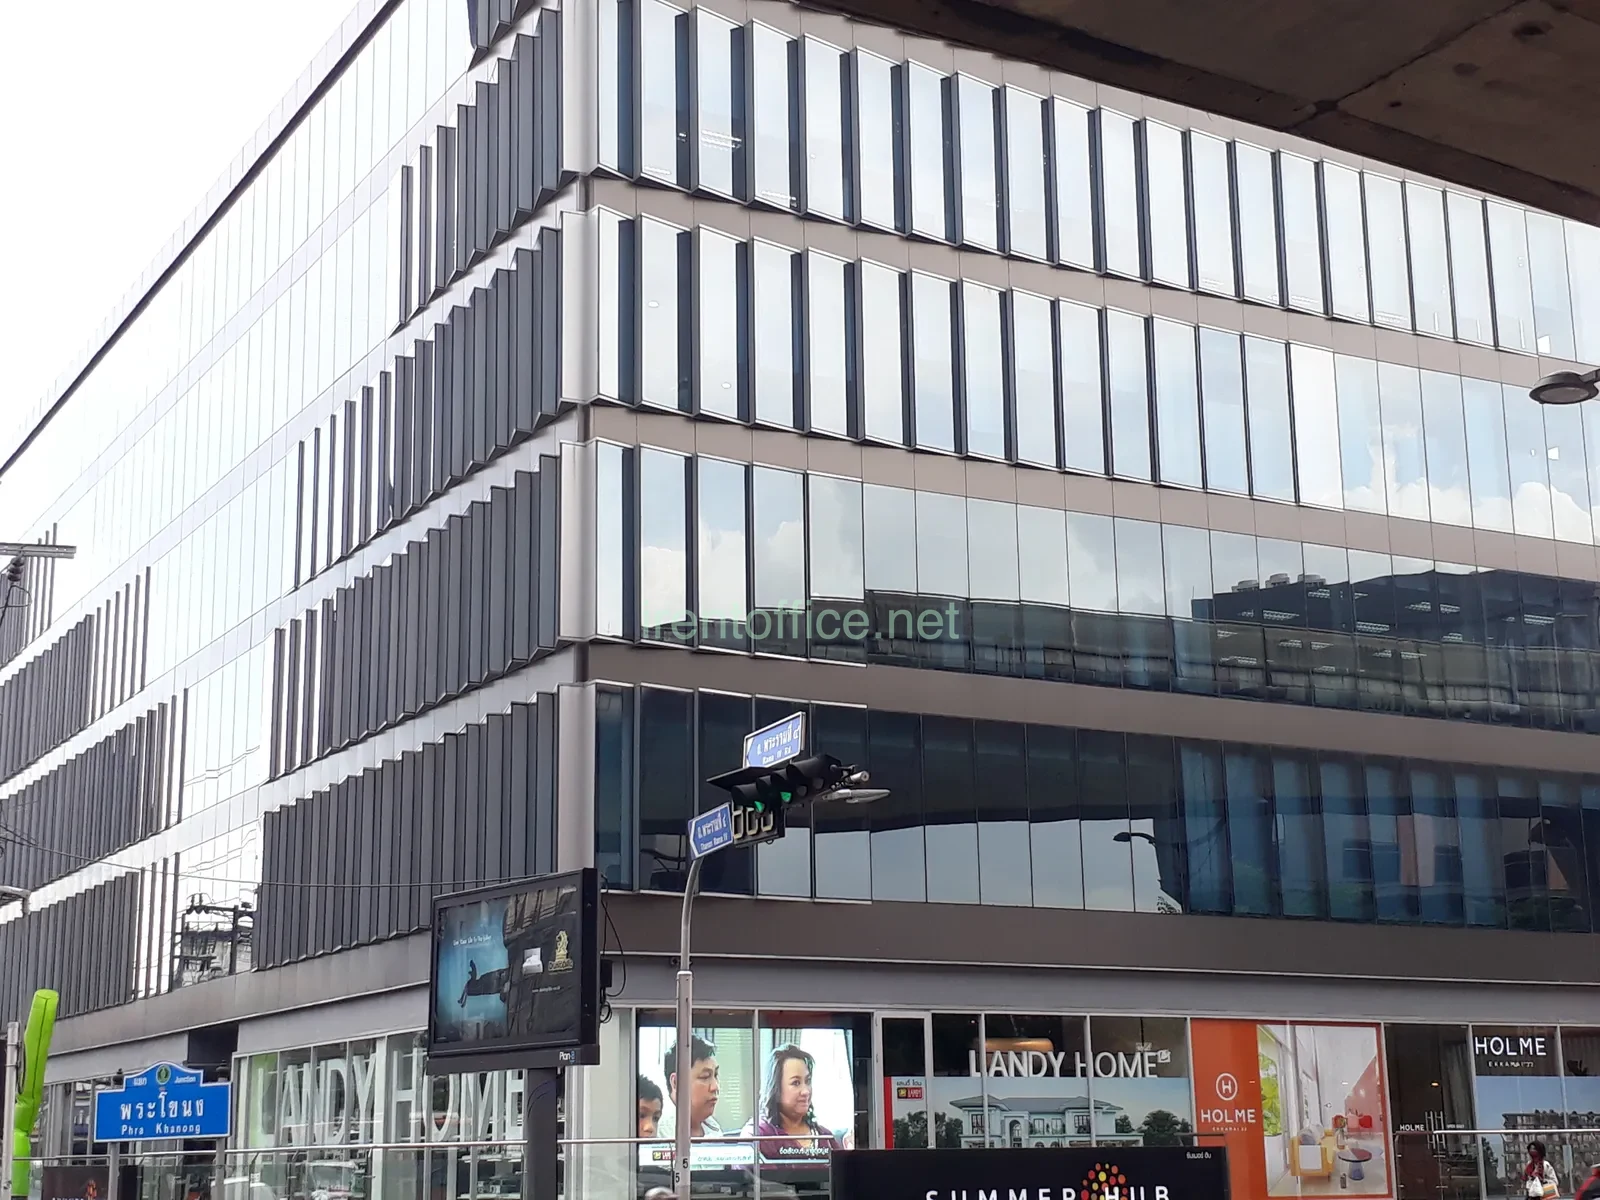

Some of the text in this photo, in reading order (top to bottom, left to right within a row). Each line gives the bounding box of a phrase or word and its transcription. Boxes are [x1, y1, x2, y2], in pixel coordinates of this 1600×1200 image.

[1474, 1036, 1547, 1056] HOLME
[968, 1049, 1159, 1078] LANDY HOME
[174, 1075, 197, 1085] Junction
[120, 1091, 204, 1121] พระโขนง
[257, 1053, 379, 1149] LANDY
[1200, 1109, 1257, 1124] HOLME
[121, 1122, 201, 1136] Phra Khanong
[1399, 1124, 1425, 1132] HOLME
[683, 1158, 689, 1169] 5
